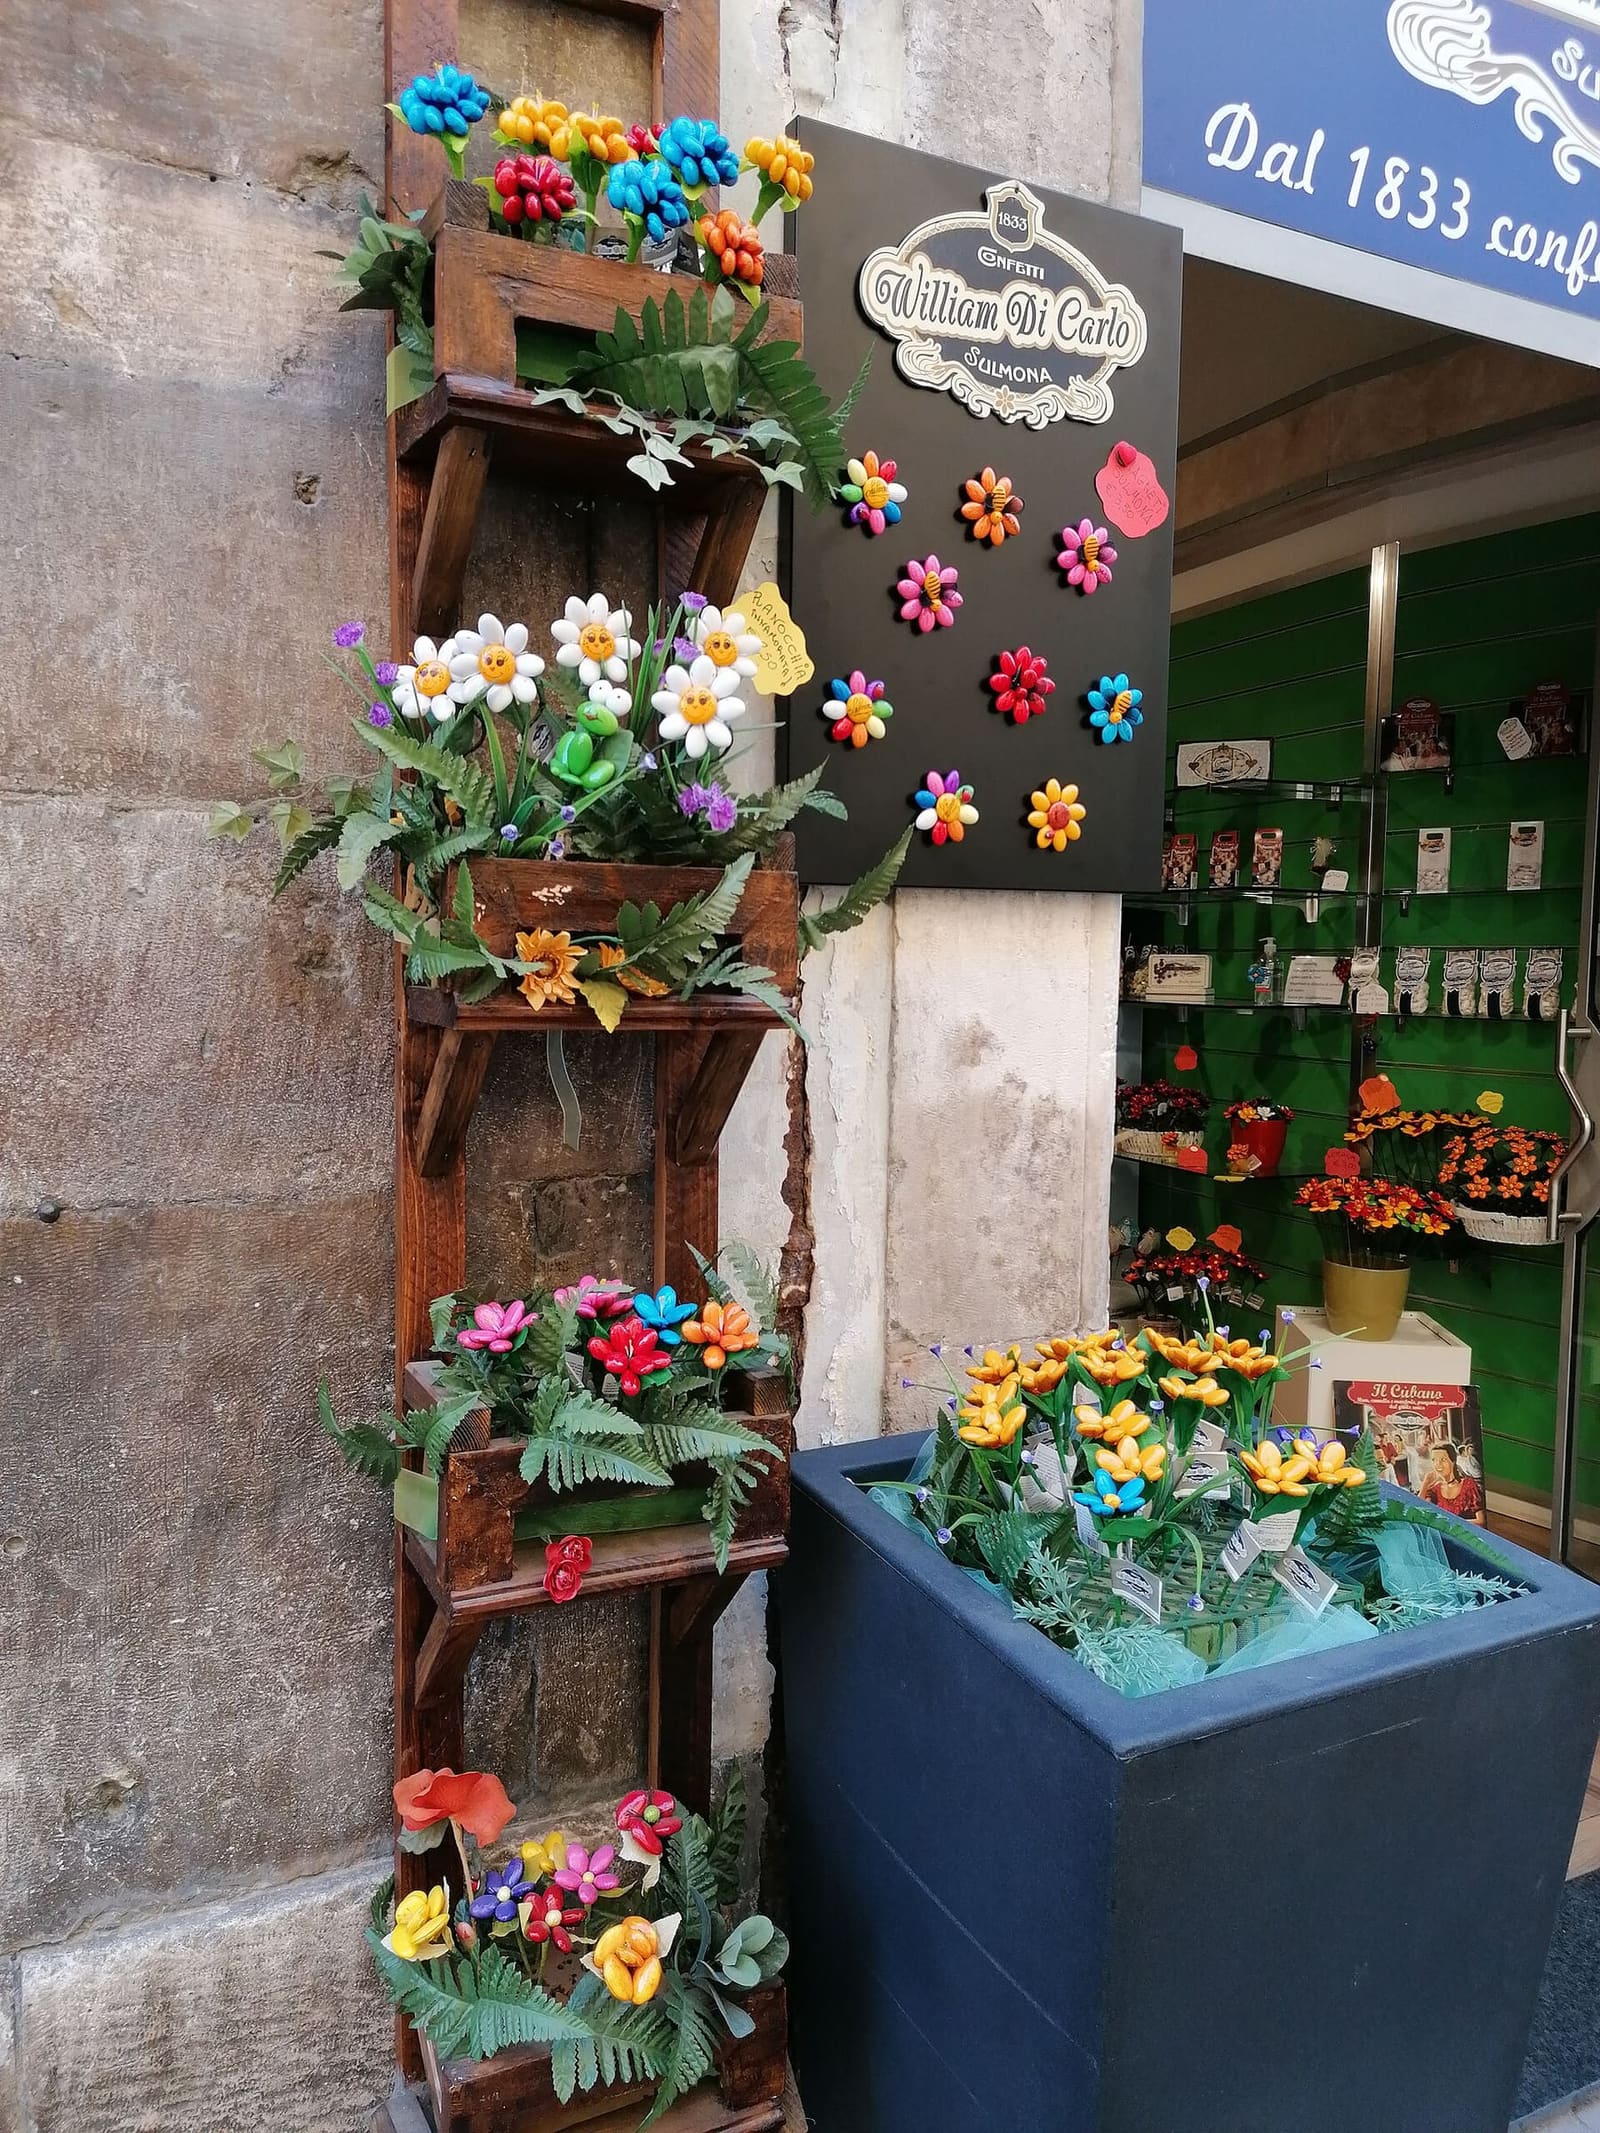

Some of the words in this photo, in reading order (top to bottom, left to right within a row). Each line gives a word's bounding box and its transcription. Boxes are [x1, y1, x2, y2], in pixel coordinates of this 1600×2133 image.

[1205, 103, 1325, 194] Dal
[1347, 146, 1471, 239] 1833
[1485, 216, 1600, 296] conf
[998, 211, 1028, 231] 1833
[875, 263, 998, 331] William
[1006, 291, 1048, 337] Di
[1057, 297, 1129, 347] Carlo
[964, 346, 1053, 383] SULMONA
[1371, 1384, 1387, 1397] Il
